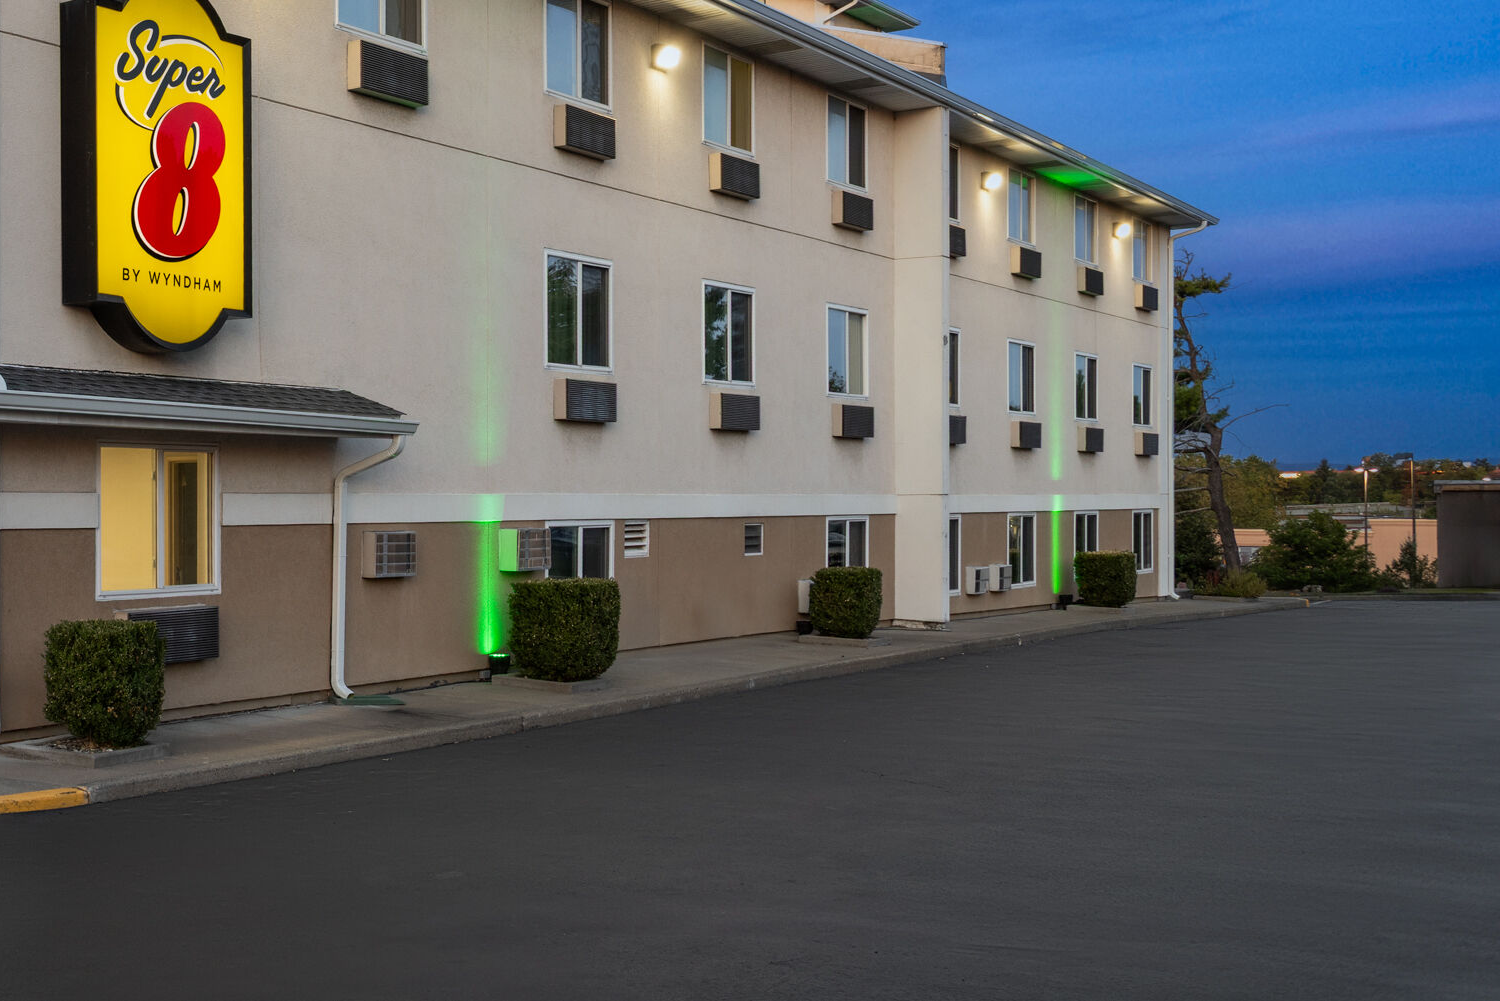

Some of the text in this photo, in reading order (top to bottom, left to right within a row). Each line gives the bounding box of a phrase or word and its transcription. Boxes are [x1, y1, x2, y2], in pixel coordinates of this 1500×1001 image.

[115, 19, 226, 119] Super
[132, 101, 226, 262] 8
[122, 267, 221, 293] BY WYNDHAM
